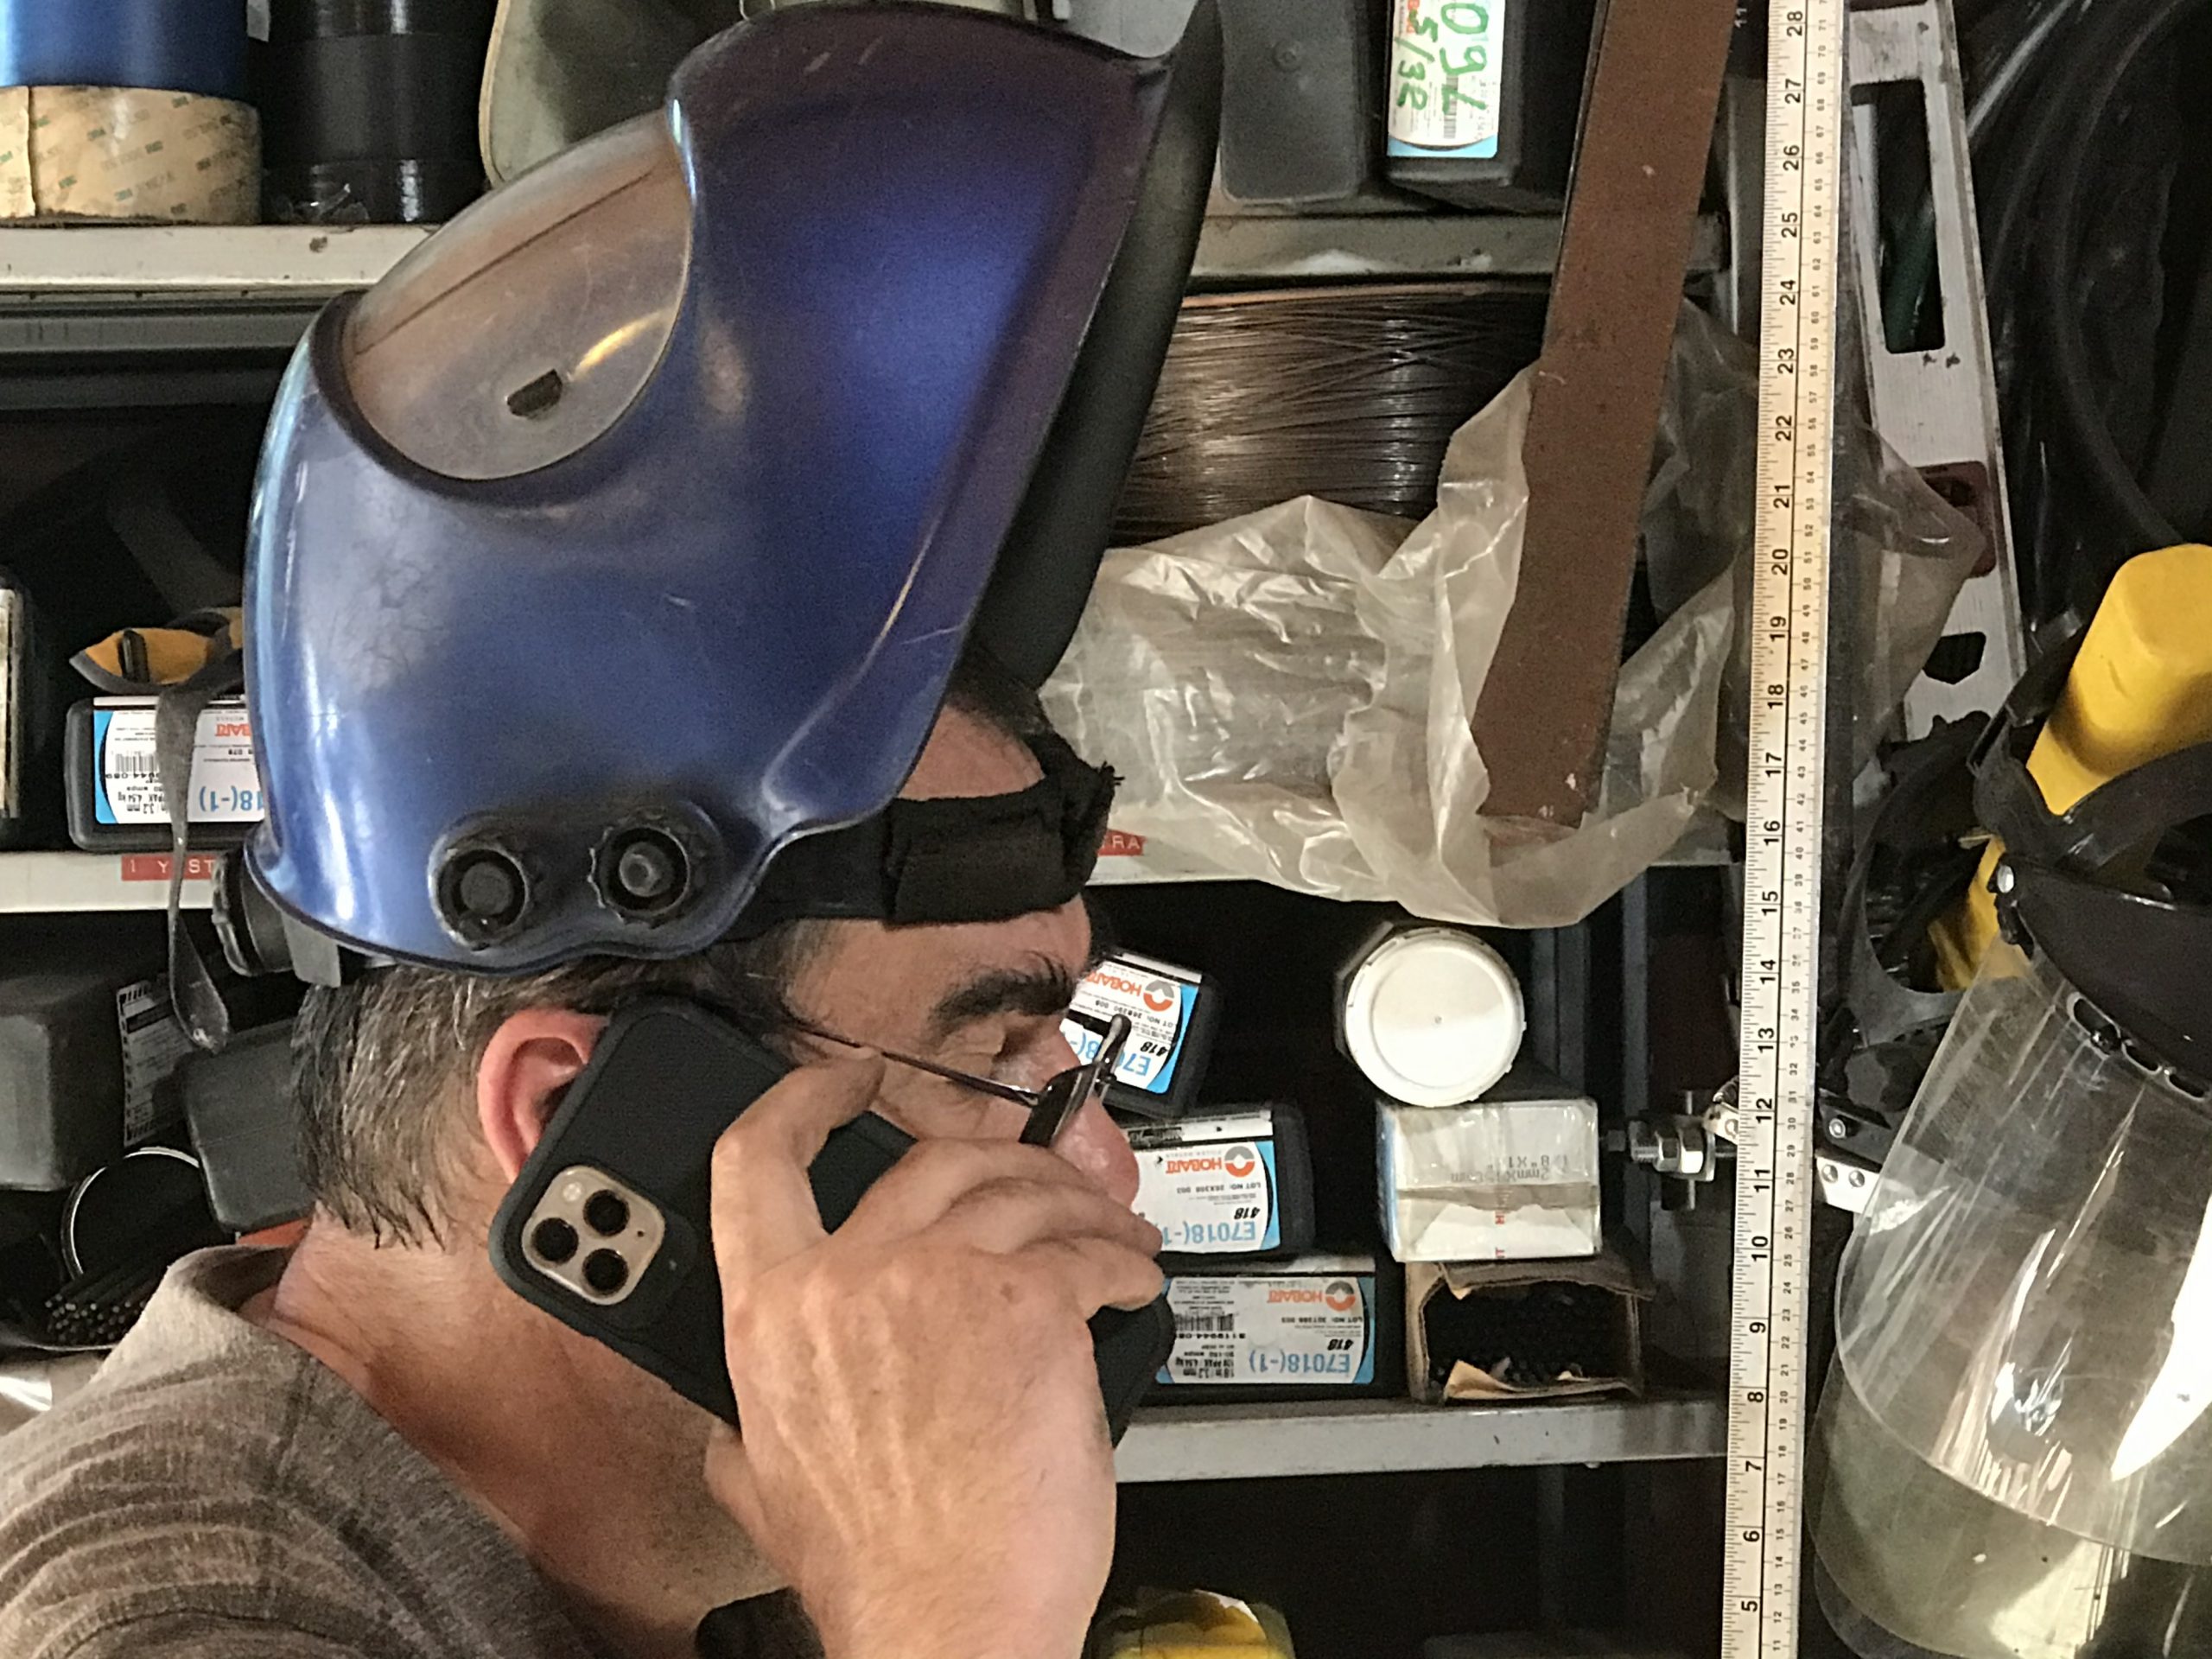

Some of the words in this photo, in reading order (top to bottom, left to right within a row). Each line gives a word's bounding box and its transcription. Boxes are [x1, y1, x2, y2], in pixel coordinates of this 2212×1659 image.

[1787, 11, 1802, 36] 28
[1817, 19, 1826, 31] 71
[1817, 46, 1826, 58] 70
[1395, 17, 1438, 111] 5/32
[1816, 73, 1825, 85] 69
[1785, 79, 1801, 104] 27
[1816, 99, 1825, 111] 68
[1815, 125, 1823, 137] 67
[1783, 145, 1799, 170] 26
[1815, 152, 1823, 164] 66
[1814, 179, 1822, 191] 65
[1813, 205, 1821, 217] 64
[1782, 213, 1798, 238] 25
[1812, 232, 1821, 244] 63
[1812, 258, 1821, 270] 62
[1780, 280, 1796, 304] 24
[1811, 285, 1820, 297] 61
[1810, 312, 1819, 324] 60
[1809, 338, 1818, 350] 59
[1777, 348, 1794, 373] 23
[1808, 365, 1817, 377] 58
[1808, 391, 1816, 404] 57
[1776, 416, 1791, 441] 22
[1808, 417, 1816, 429] 56
[1806, 444, 1815, 456] 55
[1806, 471, 1815, 483] 54
[1774, 485, 1789, 508] 21
[1805, 498, 1814, 510] 53
[1804, 524, 1813, 537] 52
[1772, 550, 1788, 575] 20
[1802, 551, 1811, 563] 51
[1802, 578, 1811, 590] 50
[1802, 605, 1810, 617] 49
[1770, 617, 1785, 641] 19
[1801, 632, 1809, 644] 48
[1800, 658, 1808, 671] 47
[1768, 684, 1783, 709] 18
[1799, 712, 1808, 724] 45
[214, 724, 251, 737] BART
[1798, 740, 1807, 752] 44
[1766, 753, 1782, 777] 17
[1796, 766, 1805, 779] 43
[199, 786, 264, 812] 18(-1)
[1796, 793, 1805, 805] 42
[1796, 820, 1804, 832] 41
[1764, 821, 1780, 845] 16
[1795, 847, 1803, 859] 40
[1794, 874, 1802, 887] 39
[1762, 891, 1777, 915] 15
[1760, 959, 1776, 984] 14
[1791, 982, 1800, 994] 35
[1758, 1028, 1774, 1052] 13
[1141, 1041, 1168, 1057] 418
[1789, 1064, 1797, 1076] 32
[1756, 1098, 1772, 1122] 12
[1787, 1117, 1796, 1129] 30
[1786, 1145, 1795, 1157] 29
[1166, 1157, 1222, 1173] HOBART
[1754, 1169, 1770, 1192] 11
[1785, 1173, 1794, 1185] 28
[1784, 1200, 1793, 1212] 27
[1234, 1207, 1260, 1219] 418
[1160, 1221, 1255, 1244] E7018(-1
[1784, 1227, 1793, 1239] 26
[1751, 1236, 1768, 1262] 10
[1783, 1255, 1792, 1267] 25
[1783, 1281, 1791, 1294] 24
[1267, 1290, 1323, 1303] HOBART
[1782, 1309, 1790, 1321] 23
[1750, 1322, 1765, 1333] 9
[1327, 1339, 1354, 1351] 418
[1781, 1337, 1789, 1349] 22
[1249, 1349, 1350, 1373] E7018(-1)
[1780, 1364, 1789, 1376] 21
[1747, 1391, 1764, 1402] 8
[1779, 1391, 1788, 1403] 20
[1778, 1418, 1787, 1430] 19
[1777, 1446, 1786, 1458] 18
[1745, 1461, 1762, 1471] 7
[1776, 1472, 1784, 1484] 17
[1776, 1501, 1784, 1513] 16
[1744, 1531, 1759, 1541] 6
[1775, 1528, 1783, 1540] 15
[1774, 1556, 1783, 1568] 14
[1773, 1584, 1782, 1596] 13
[1742, 1600, 1758, 1611] 5
[1773, 1611, 1782, 1624] 12
[1771, 1640, 1780, 1652] 11
